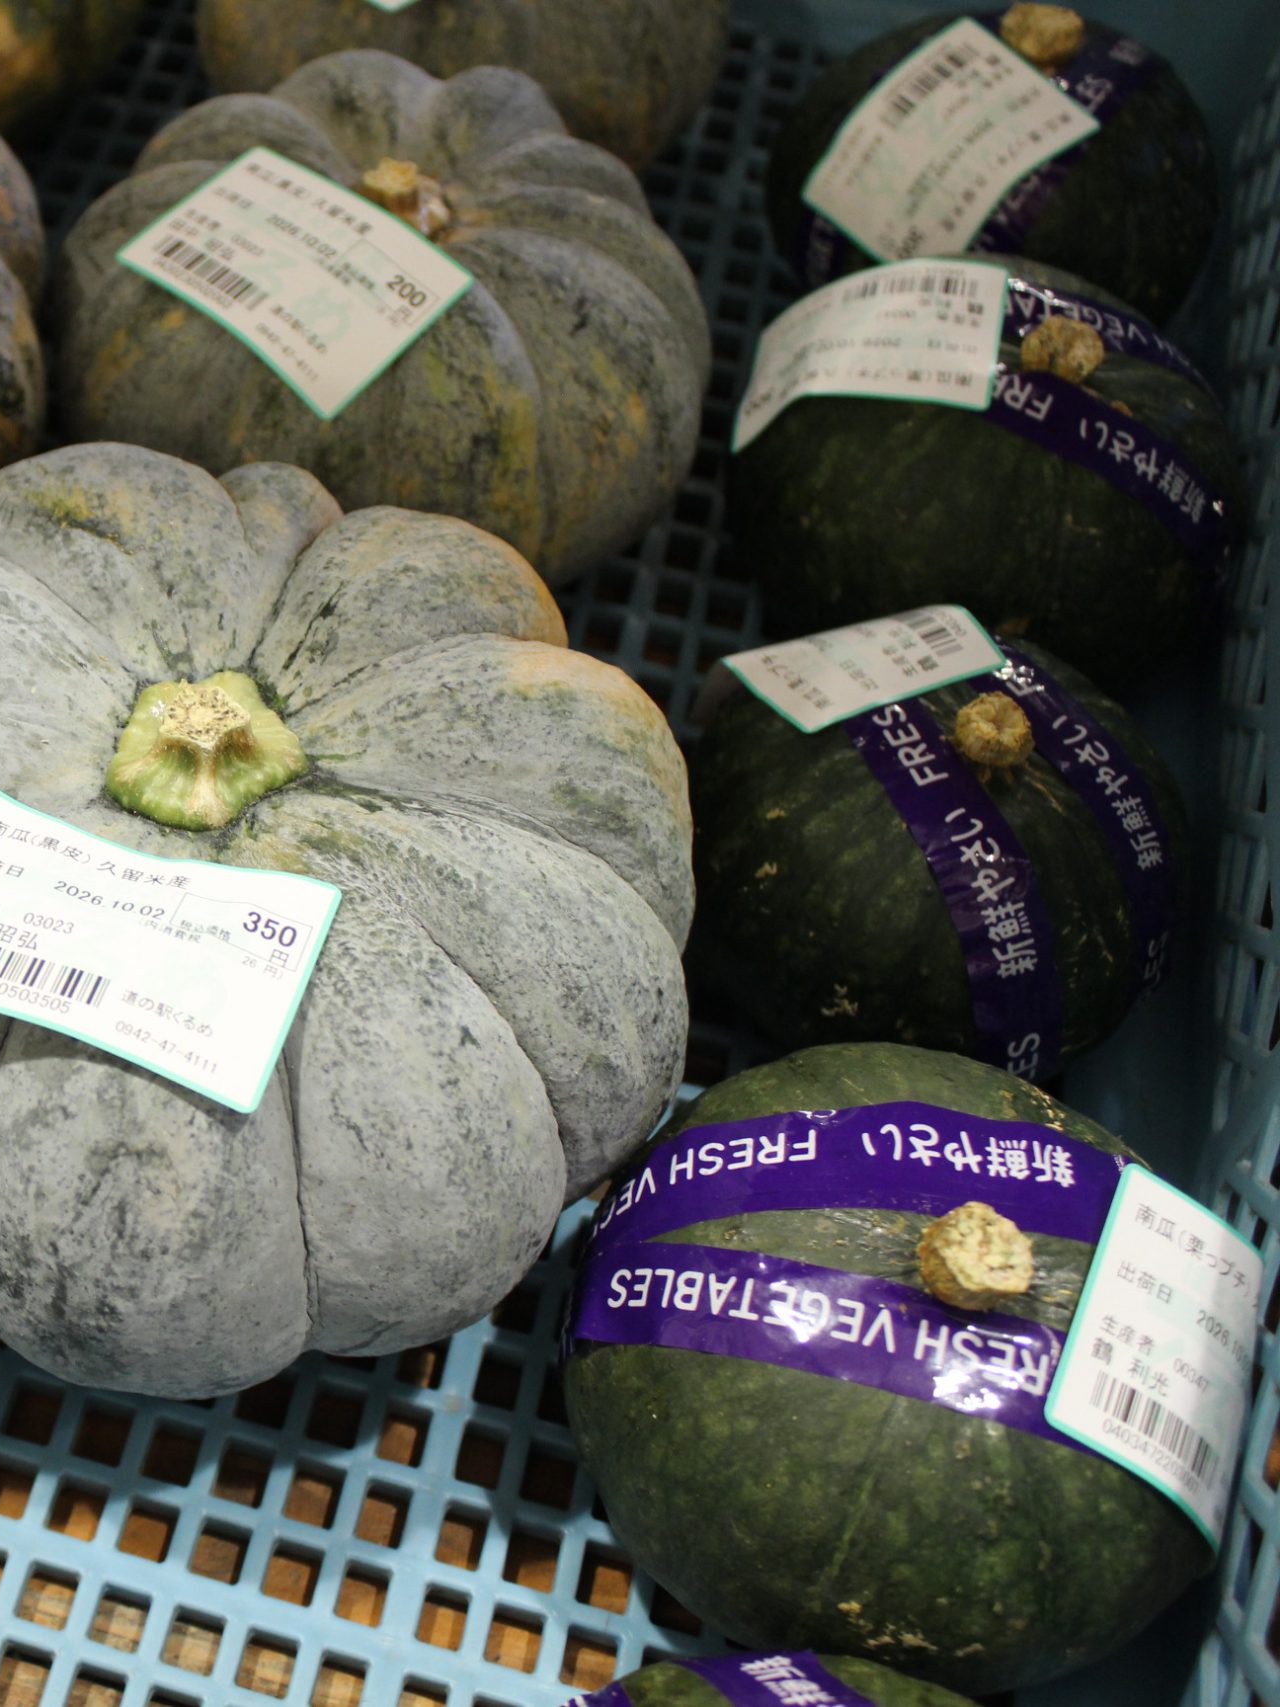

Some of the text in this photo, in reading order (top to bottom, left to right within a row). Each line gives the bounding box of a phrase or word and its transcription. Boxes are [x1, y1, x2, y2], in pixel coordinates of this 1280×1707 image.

[386, 274, 428, 308] 200
[1051, 713, 1164, 872] 新鮮やさい
[871, 702, 1038, 980] 新鮮やさい FRES
[97, 859, 192, 890] 久留米産
[53, 879, 166, 921] 2026.10.02
[22, 911, 76, 936] 03023
[241, 909, 299, 949] 350
[268, 948, 291, 968] 円
[121, 988, 215, 1039] 道の駅くるめ
[114, 1018, 219, 1077] 0942-47-4111
[668, 1128, 818, 1186] FRESH
[861, 1123, 1076, 1188] 新鮮やさい
[1116, 1259, 1173, 1305] 出荷日
[606, 1267, 1051, 1397] RESH VEGETABLES
[1099, 1312, 1156, 1358] 生産者
[1127, 1356, 1170, 1398] 利光
[739, 1654, 848, 1707] 新鮮
